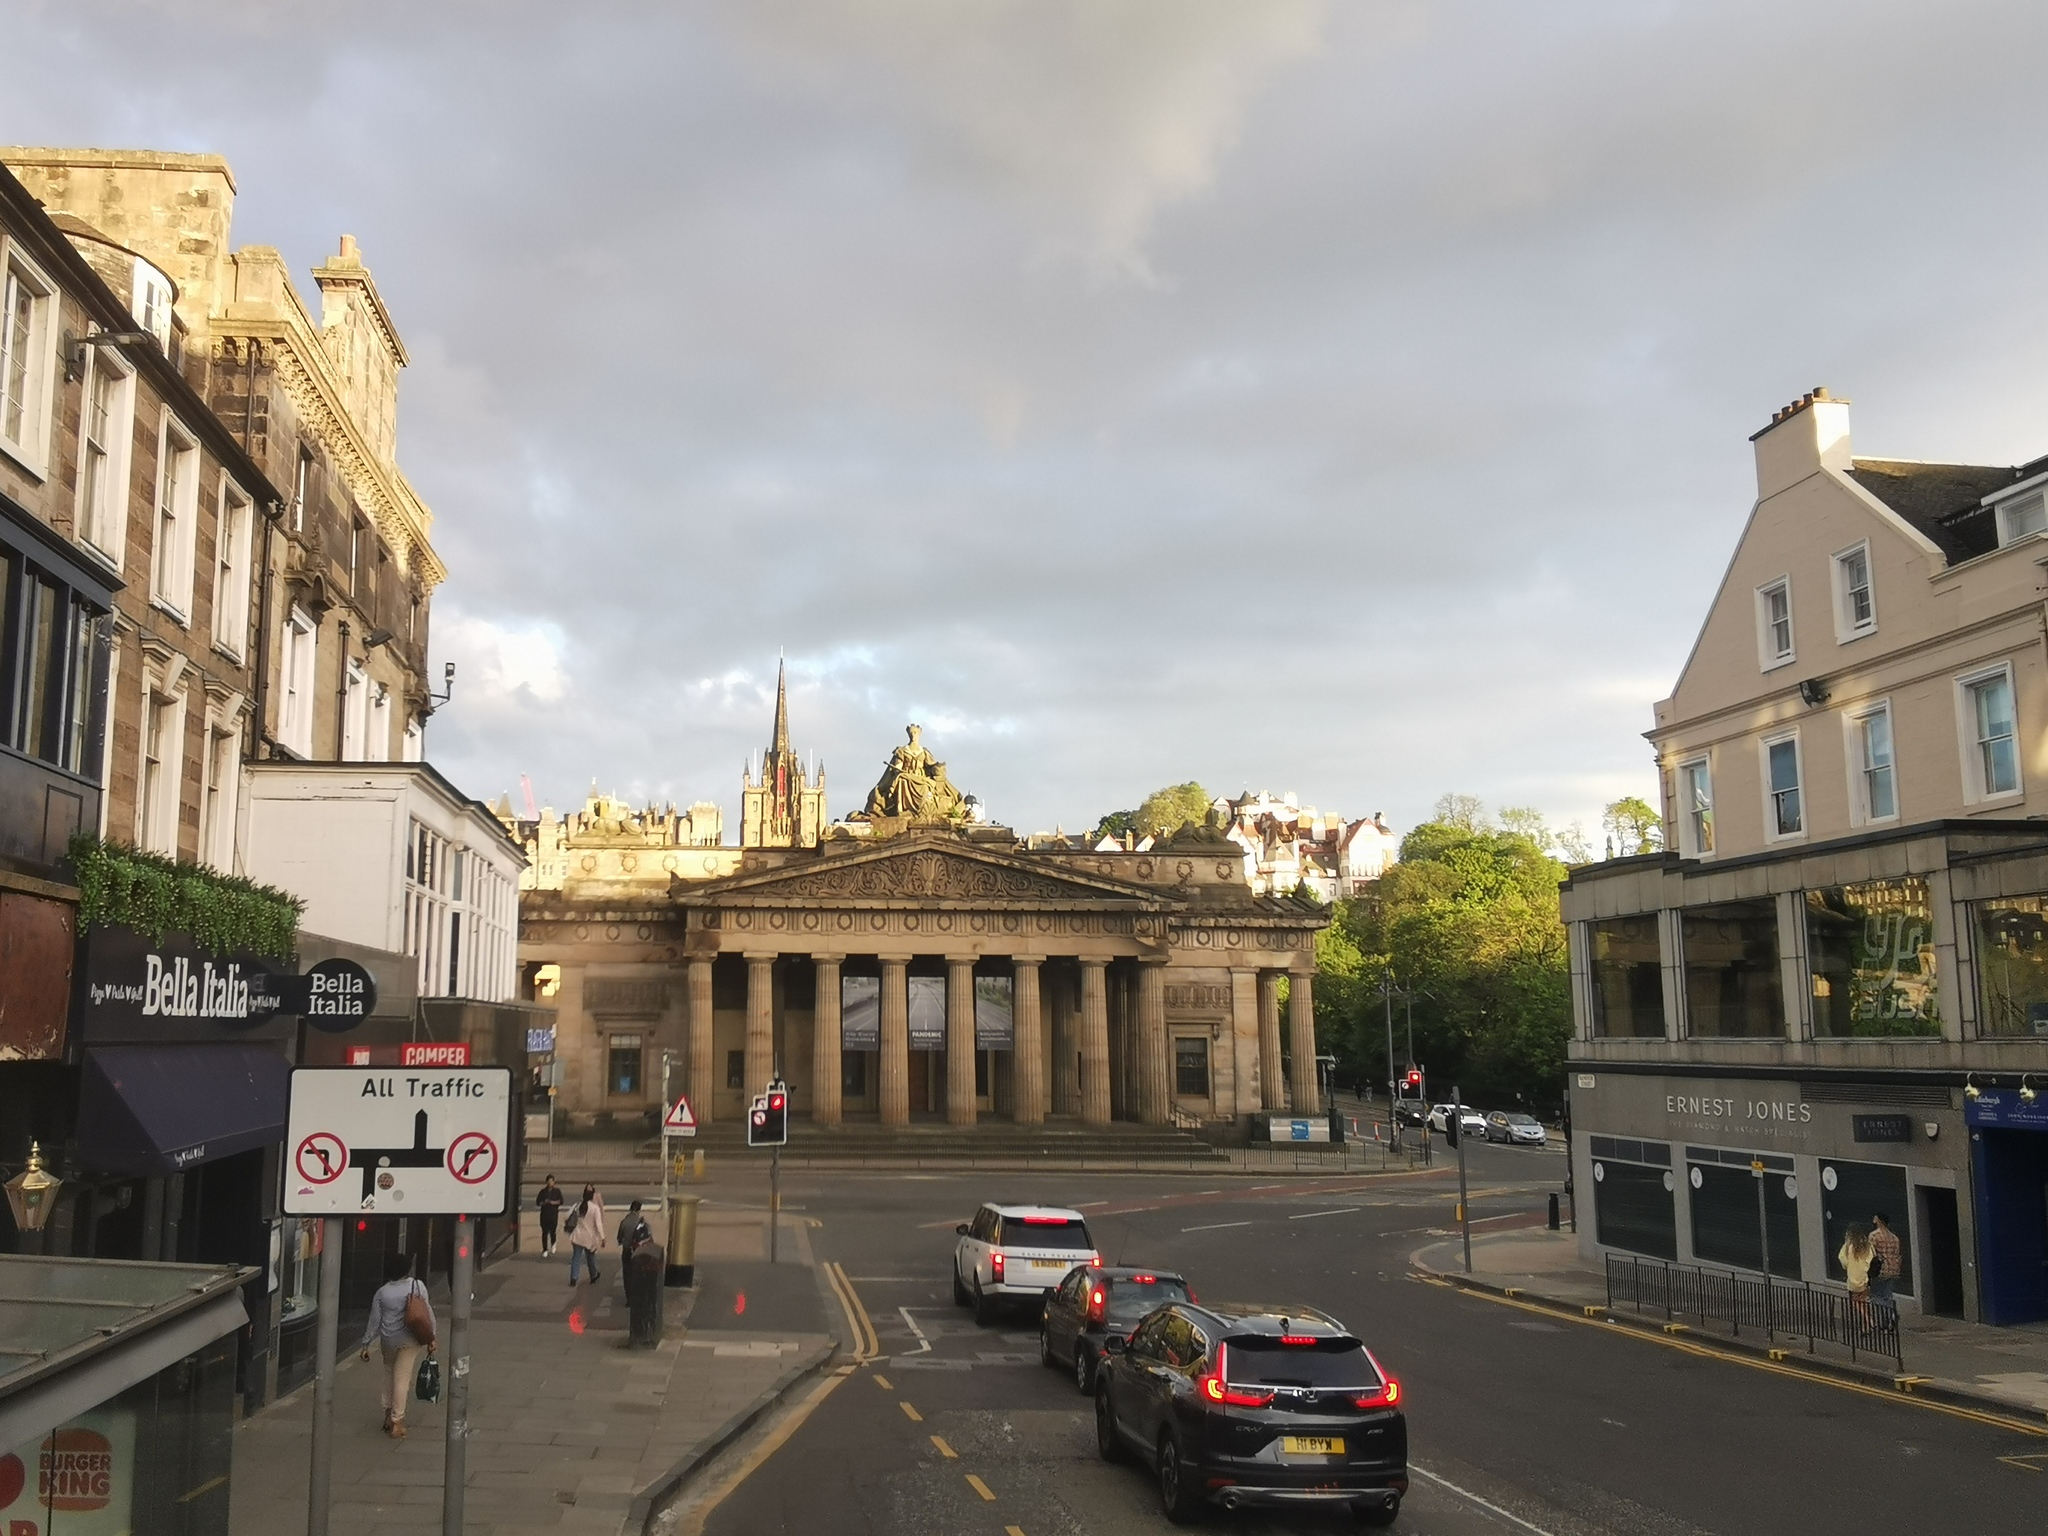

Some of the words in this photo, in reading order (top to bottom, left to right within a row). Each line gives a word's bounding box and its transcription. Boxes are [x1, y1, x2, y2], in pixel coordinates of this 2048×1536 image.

[142, 954, 198, 1017] Bella
[200, 962, 248, 1018] Italia
[310, 973, 364, 993] Bella
[308, 995, 364, 1015] Italia
[405, 1047, 465, 1066] CAMPER
[361, 1078, 394, 1097] All
[406, 1078, 485, 1097] Traffic
[1666, 1096, 1734, 1117] ERNEST
[1746, 1101, 1811, 1122] JONES
[1863, 1120, 1902, 1128] ERNEST
[40, 1453, 111, 1471] BURGER
[39, 1471, 110, 1496] KING
